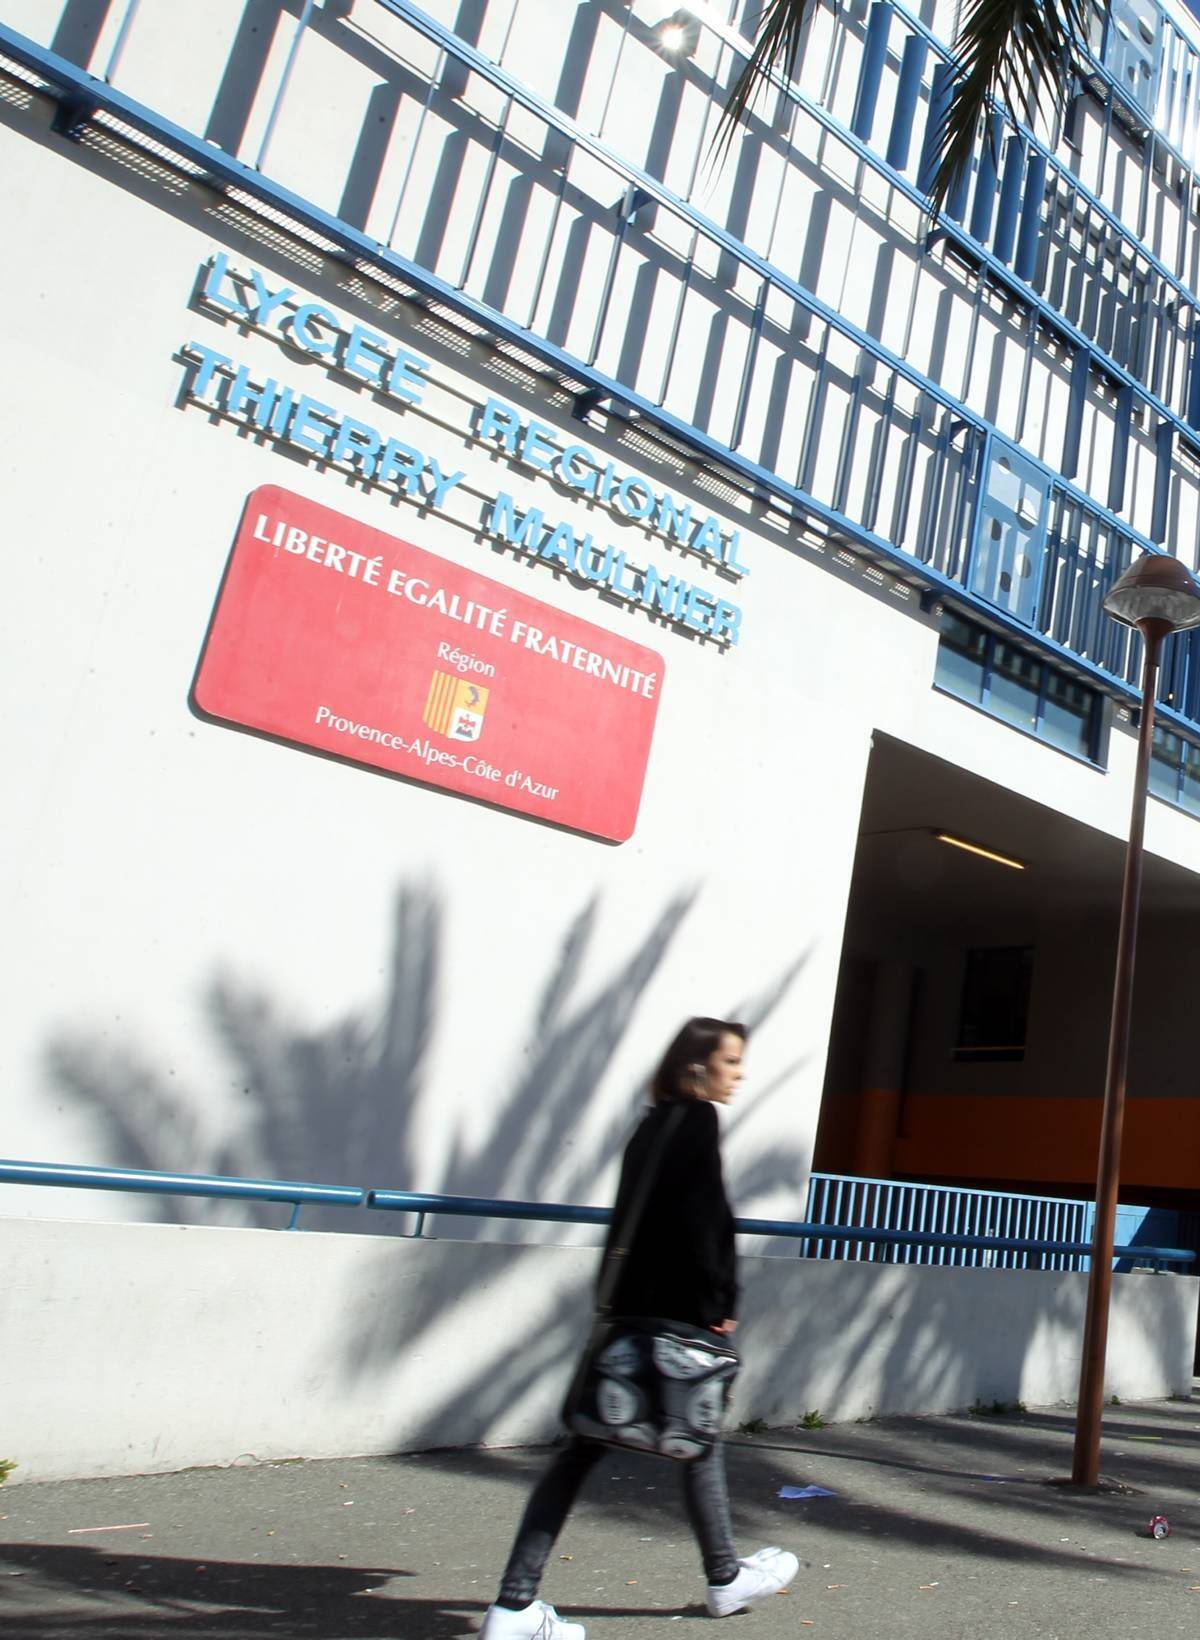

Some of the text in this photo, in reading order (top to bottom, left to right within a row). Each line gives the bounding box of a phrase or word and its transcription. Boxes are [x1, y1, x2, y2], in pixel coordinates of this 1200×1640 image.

[189, 341, 743, 646] THIERRY MAULNIER
[204, 251, 749, 576] LYCEE REGIONAL
[253, 514, 657, 699] LIBERTÉ EGALITÉ FRATERNITÉ
[437, 642, 495, 678] Région
[315, 706, 560, 801] Provence-Alpes-Côte d'Azur
